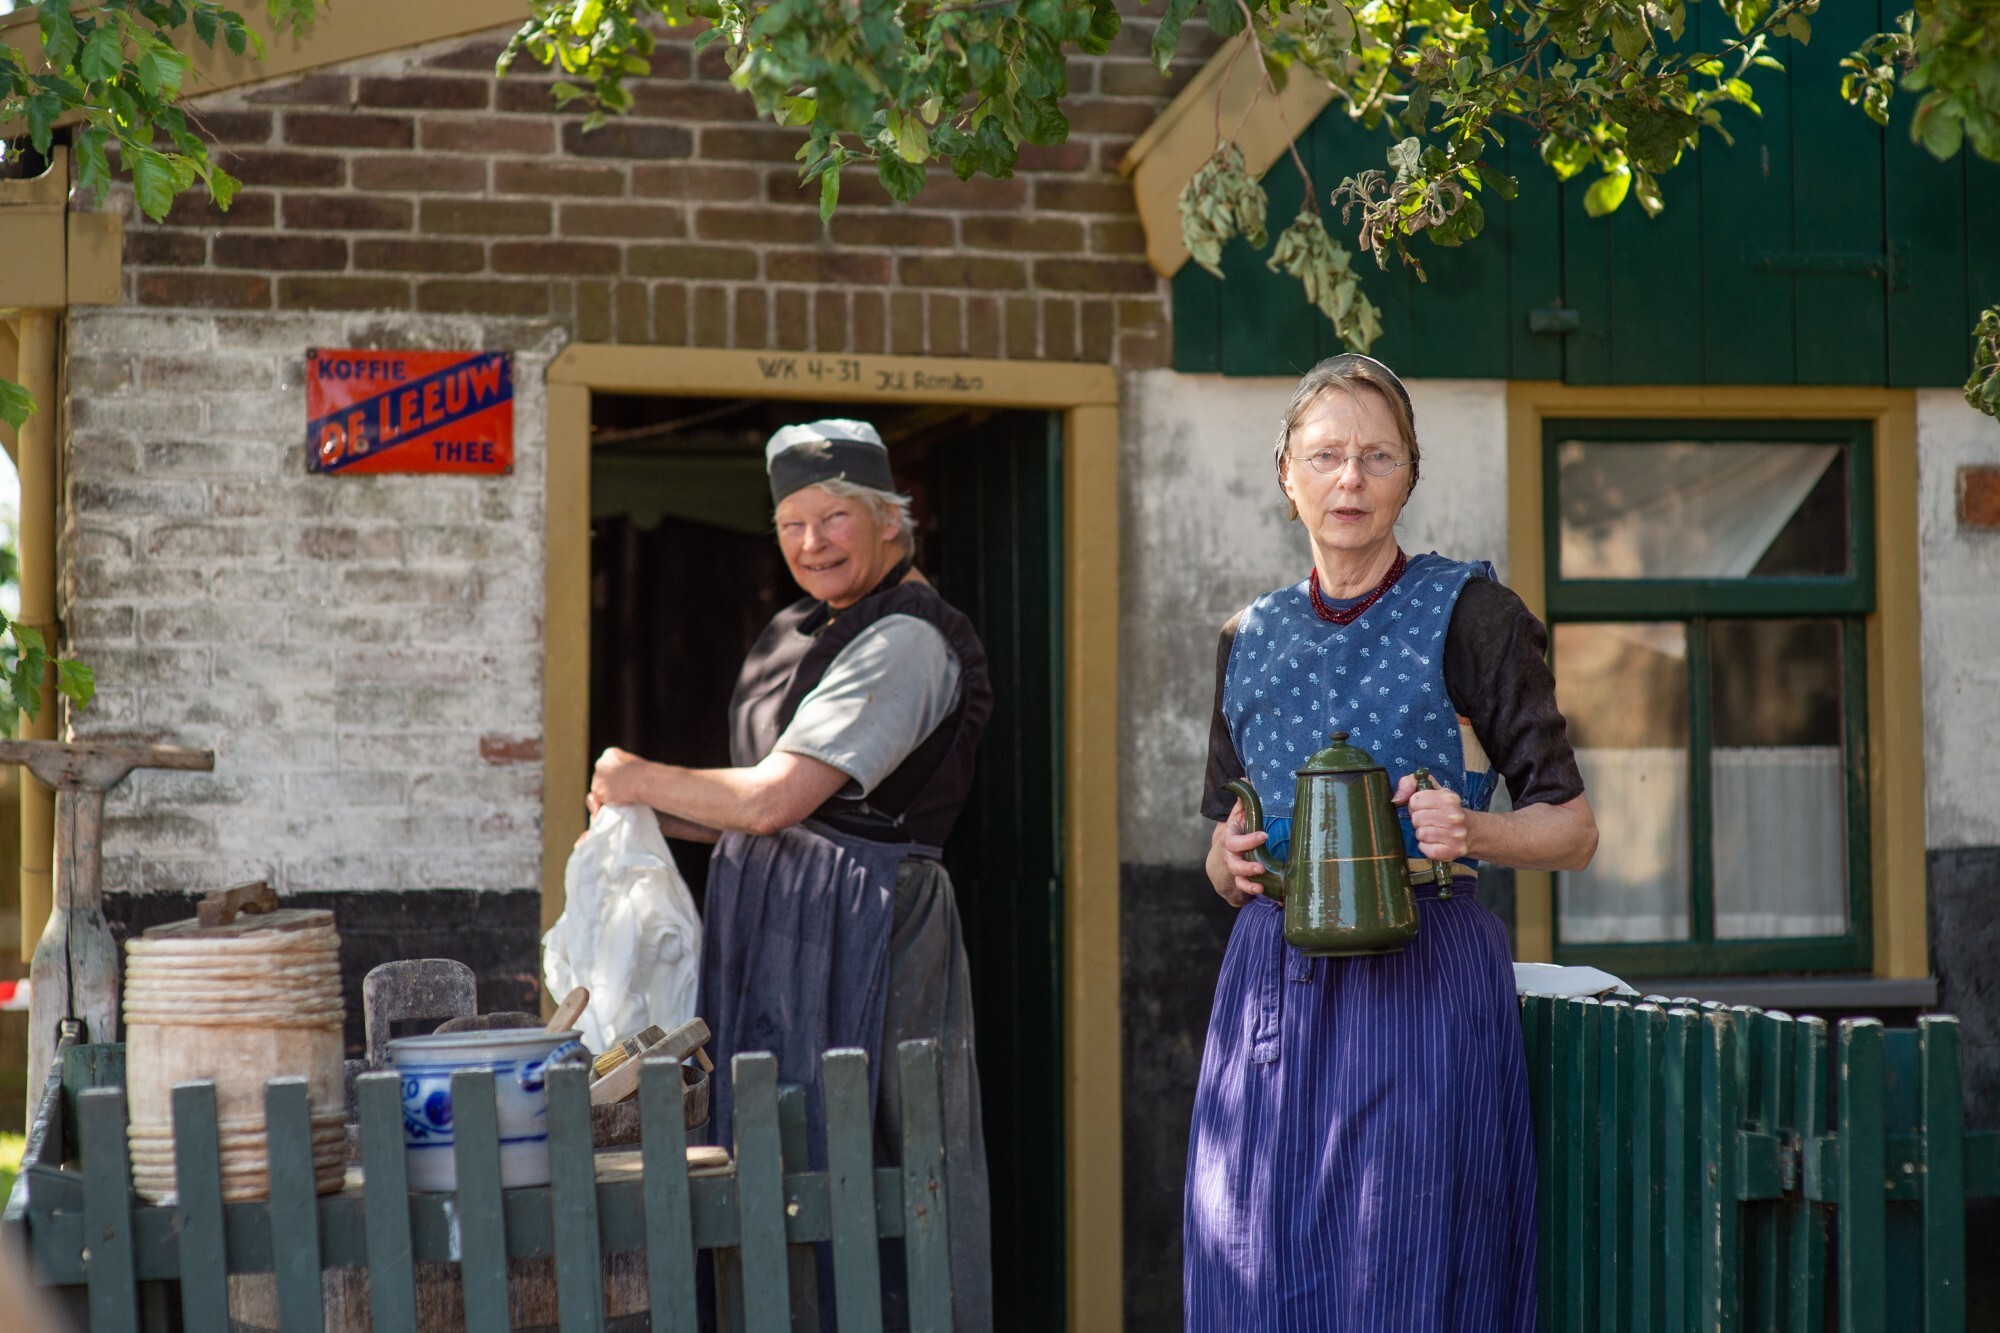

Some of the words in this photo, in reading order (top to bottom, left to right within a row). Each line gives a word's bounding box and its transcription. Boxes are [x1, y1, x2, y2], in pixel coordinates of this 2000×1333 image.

[318, 360, 405, 380] KOFFIE
[756, 357, 798, 379] WK
[807, 359, 860, 382] 4-31
[320, 410, 369, 466] DE
[379, 357, 501, 443] LEEUW
[433, 441, 495, 462] THEE
